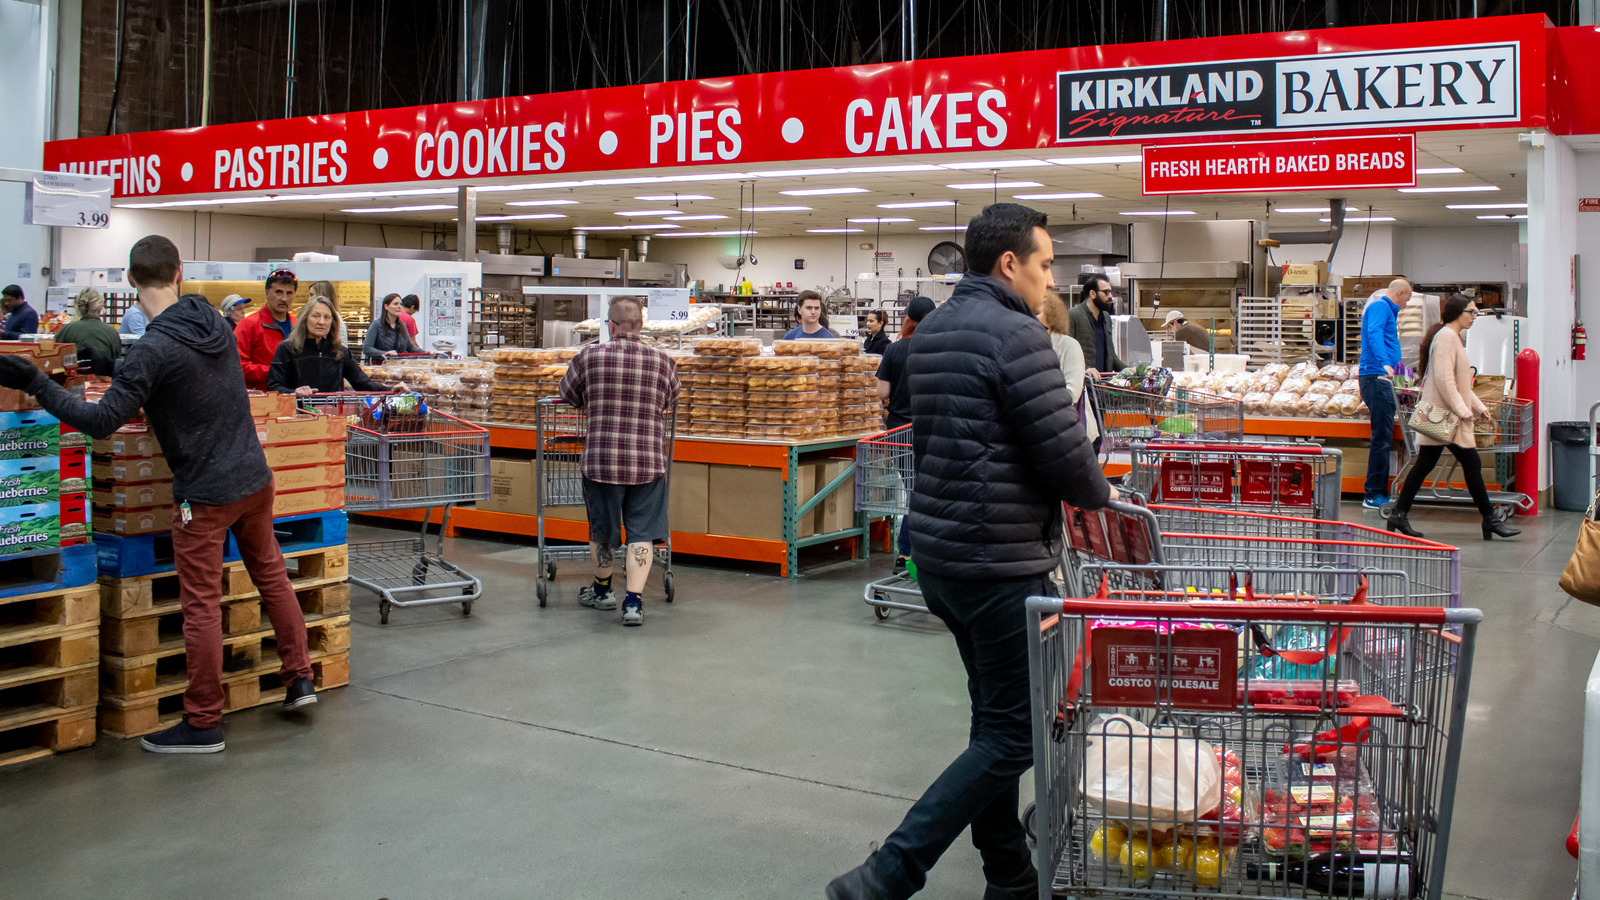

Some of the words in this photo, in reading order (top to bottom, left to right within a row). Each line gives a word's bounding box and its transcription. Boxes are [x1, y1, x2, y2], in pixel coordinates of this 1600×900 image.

[1071, 69, 1264, 111] KIRKLAND
[1282, 58, 1506, 115] BAKERY
[1069, 106, 1262, 138] Signature
[59, 154, 161, 196] FINS
[214, 139, 348, 190] PASTRIES
[415, 121, 566, 179] COOKIES
[650, 107, 742, 164] PIES
[845, 89, 1008, 154] CAKES
[1150, 160, 1200, 178] FRESH
[1205, 157, 1271, 176] HEARTH
[1275, 154, 1330, 173] BAKED
[1335, 151, 1406, 171] BREADS
[77, 212, 109, 227] 3.99
[670, 310, 689, 320] 5.99
[0, 429, 21, 440] Fresh
[0, 476, 21, 487] Fresh
[0, 523, 21, 534] Fresh
[1108, 678, 1152, 688] COSTCO
